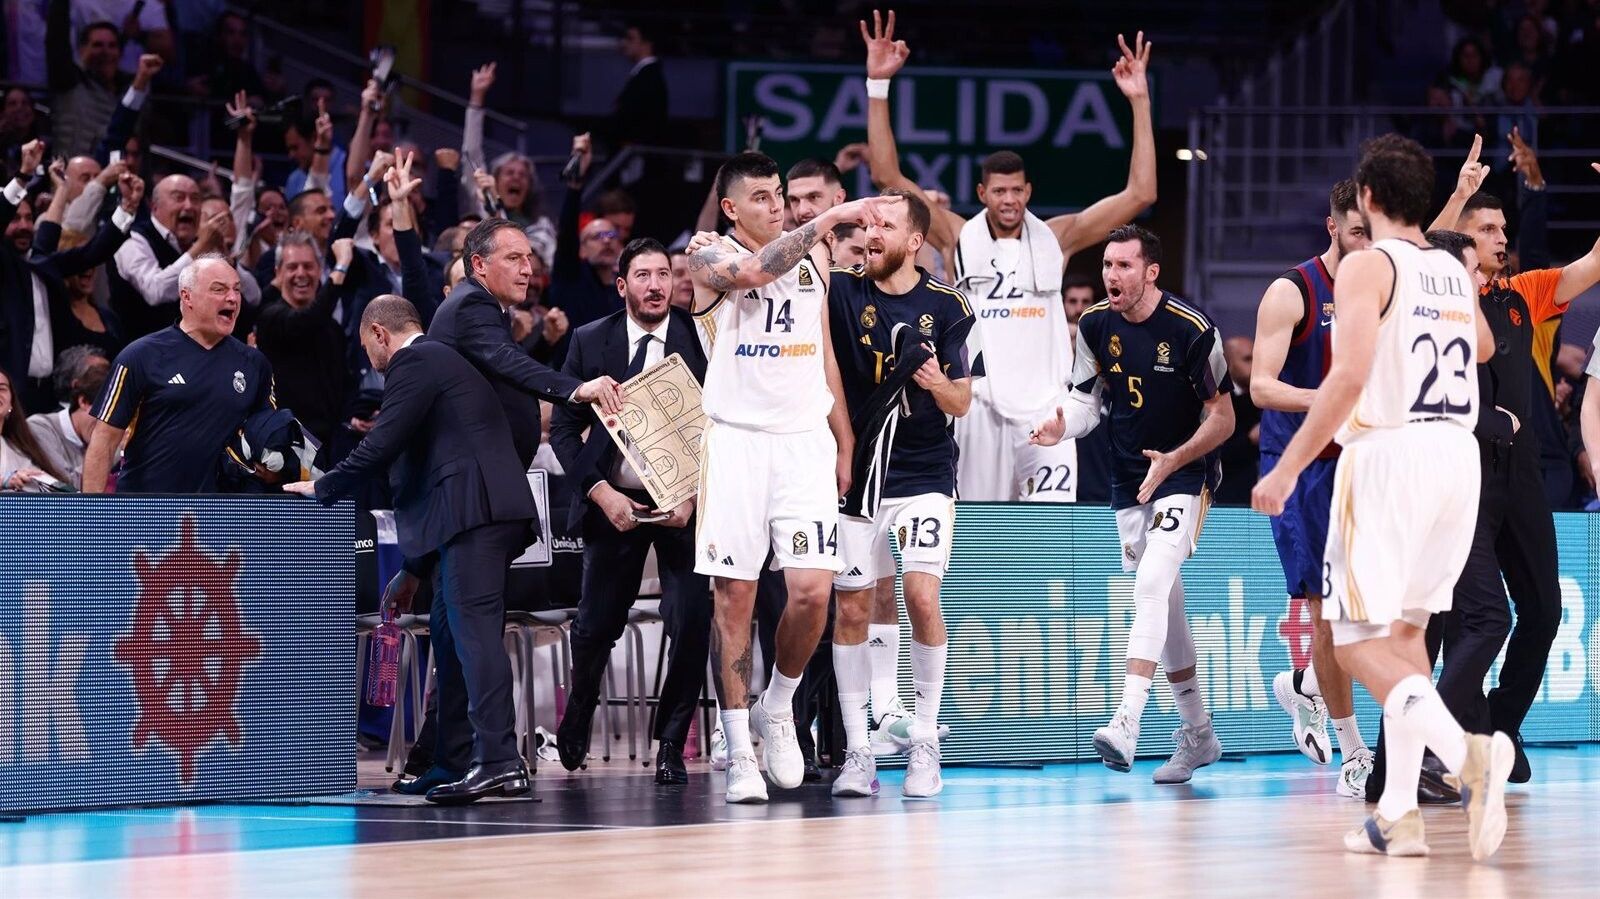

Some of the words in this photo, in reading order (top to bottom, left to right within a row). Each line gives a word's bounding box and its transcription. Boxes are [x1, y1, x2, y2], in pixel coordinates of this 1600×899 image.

[754, 72, 1124, 148] SALIDA
[856, 151, 986, 207] XI
[763, 297, 795, 333] 14
[980, 306, 1046, 320] UTOHERO
[734, 343, 817, 358] AUTOHERO
[1409, 332, 1472, 416] 23
[1127, 376, 1144, 409] 5
[1035, 463, 1072, 493] 22
[909, 516, 942, 549] 13
[1159, 507, 1184, 532] 5
[812, 520, 838, 557] 14
